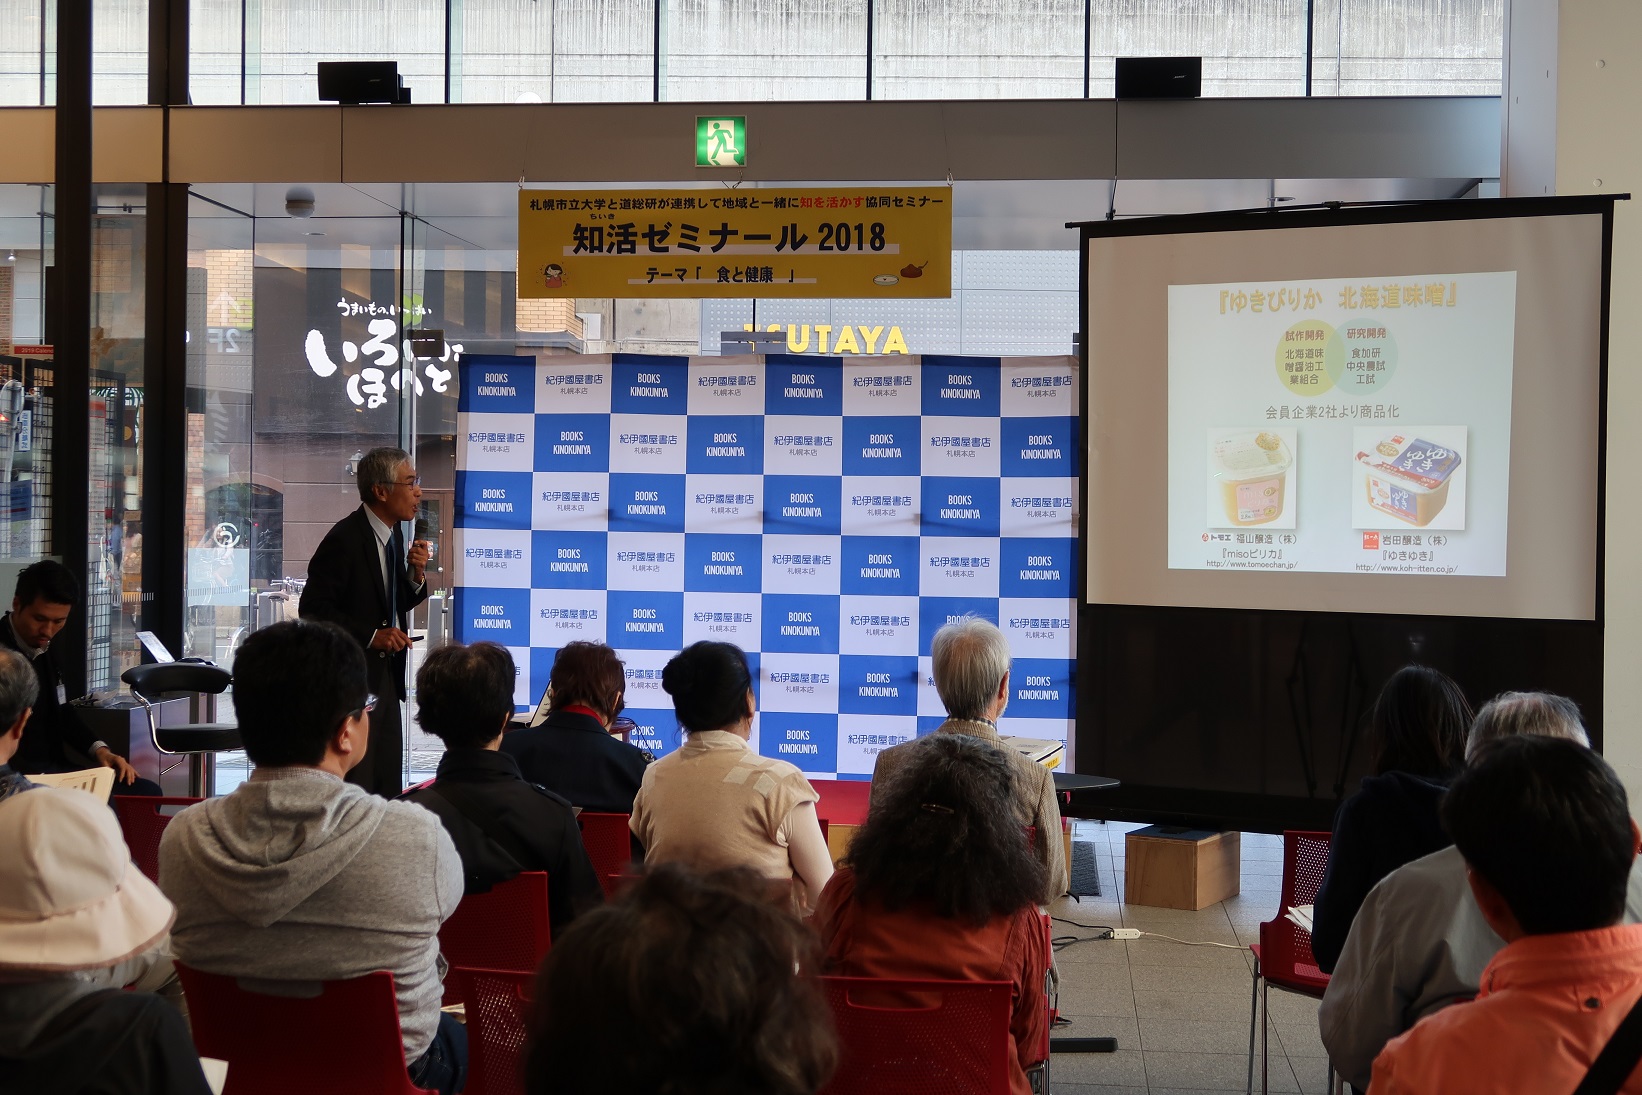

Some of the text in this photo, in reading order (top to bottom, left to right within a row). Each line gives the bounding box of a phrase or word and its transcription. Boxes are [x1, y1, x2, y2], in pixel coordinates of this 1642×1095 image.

[530, 196, 943, 211] 札幌市立大学と道総研が連携して地域と一緒に知を活かす協同セミナー
[573, 222, 885, 254] 知活ゼミナール 2018
[1285, 329, 1325, 342] 試作開発
[1346, 327, 1387, 339] 研究開発
[1285, 348, 1325, 360] 北海道味
[1351, 347, 1381, 359] 食加研
[1346, 360, 1386, 372] 中央農試
[485, 373, 508, 383] BOOKS
[546, 374, 603, 385] 紀伊國屋書店
[638, 374, 660, 383] BOOKS
[698, 376, 756, 386] 紀伊國屋書店
[792, 374, 814, 384] BOOKS
[853, 376, 912, 387] 紀伊國屋書店
[948, 375, 972, 384] BOOKS
[1012, 376, 1072, 387] 紀伊國屋書店
[1289, 374, 1319, 385] 業組合
[1356, 374, 1376, 385] 工試
[478, 386, 516, 396] KINOKUNIYA
[630, 387, 668, 397] KINOKUNIYA
[784, 388, 823, 398] KINOKUNIYA
[869, 389, 897, 397] 札幌本店
[941, 388, 980, 399] KINOKUNIYA
[1027, 390, 1056, 398] 札幌本店
[1266, 404, 1400, 420] 会員企業2社より商品化
[468, 433, 525, 443] 紀伊國屋書店
[561, 432, 583, 441] BOOKS
[620, 434, 677, 445] 紀伊國屋書店
[714, 433, 736, 443] BOOKS
[774, 436, 832, 446] 紀伊國屋書店
[870, 434, 893, 444] BOOKS
[931, 436, 990, 447] 紀伊國屋書店
[1028, 435, 1052, 445] BOOKS
[553, 444, 591, 454] KINOKUNIYA
[706, 446, 745, 456] KINOKUNIYA
[862, 448, 901, 458] KINOKUNIYA
[946, 450, 975, 458] 札幌本店
[1021, 448, 1061, 459] KINOKUNIYA
[483, 489, 505, 498] BOOKS
[542, 492, 600, 502] 紀伊國屋書店
[635, 492, 658, 501] BOOKS
[790, 494, 813, 503] BOOKS
[696, 494, 754, 504] 紀伊國屋書店
[852, 496, 911, 506] 紀伊國屋書店
[948, 495, 972, 505] BOOKS
[1011, 497, 1072, 508] 紀伊國屋書店
[475, 502, 513, 512] KINOKUNIYA
[556, 504, 584, 512] 札幌本店
[628, 504, 666, 514] KINOKUNIYA
[711, 506, 738, 514] 札幌本店
[783, 507, 822, 517] KINOKUNIYA
[940, 508, 980, 519] KINOKUNIYA
[1027, 510, 1056, 518] 札幌本店
[466, 548, 522, 559] 紀伊國屋書店
[558, 549, 580, 559] BOOKS
[617, 552, 675, 562] 紀伊國屋書店
[712, 552, 734, 562] BOOKS
[1382, 550, 1434, 562] 『ゆきゆき』
[772, 554, 831, 564] 紀伊國屋書店
[868, 554, 892, 564] BOOKS
[930, 557, 990, 567] 紀伊國屋書店
[1028, 556, 1052, 566] BOOKS
[550, 562, 588, 572] KINOKUNIYA
[1206, 560, 1299, 570] http://www.tomoechan.jp/
[704, 565, 742, 576] KINOKUNIYA
[861, 568, 900, 578] KINOKUNIYA
[945, 570, 974, 578] 札幌本店
[1020, 570, 1060, 580] KINOKUNIYA
[481, 606, 503, 615] BOOKS
[540, 608, 598, 619] 紀伊國屋書店
[633, 609, 656, 618] BOOKS
[694, 612, 752, 623] 紀伊國屋書店
[788, 612, 812, 622] BOOKS
[850, 616, 910, 626] 紀伊國屋書店
[474, 619, 511, 629] KINOKUNIYA
[626, 622, 664, 632] KINOKUNIYA
[1010, 618, 1070, 629] 紀伊國屋書店
[781, 625, 820, 636] KINOKUNIYA
[770, 673, 829, 683] 紀伊國屋書店
[867, 673, 890, 683] BOOKS
[1026, 676, 1050, 686] BOOKS
[859, 686, 898, 697] KINOKUNIYA
[1018, 690, 1059, 700] KINOKUNIYA
[786, 730, 810, 740] BOOKS
[779, 744, 818, 754] KINOKUNIYA
